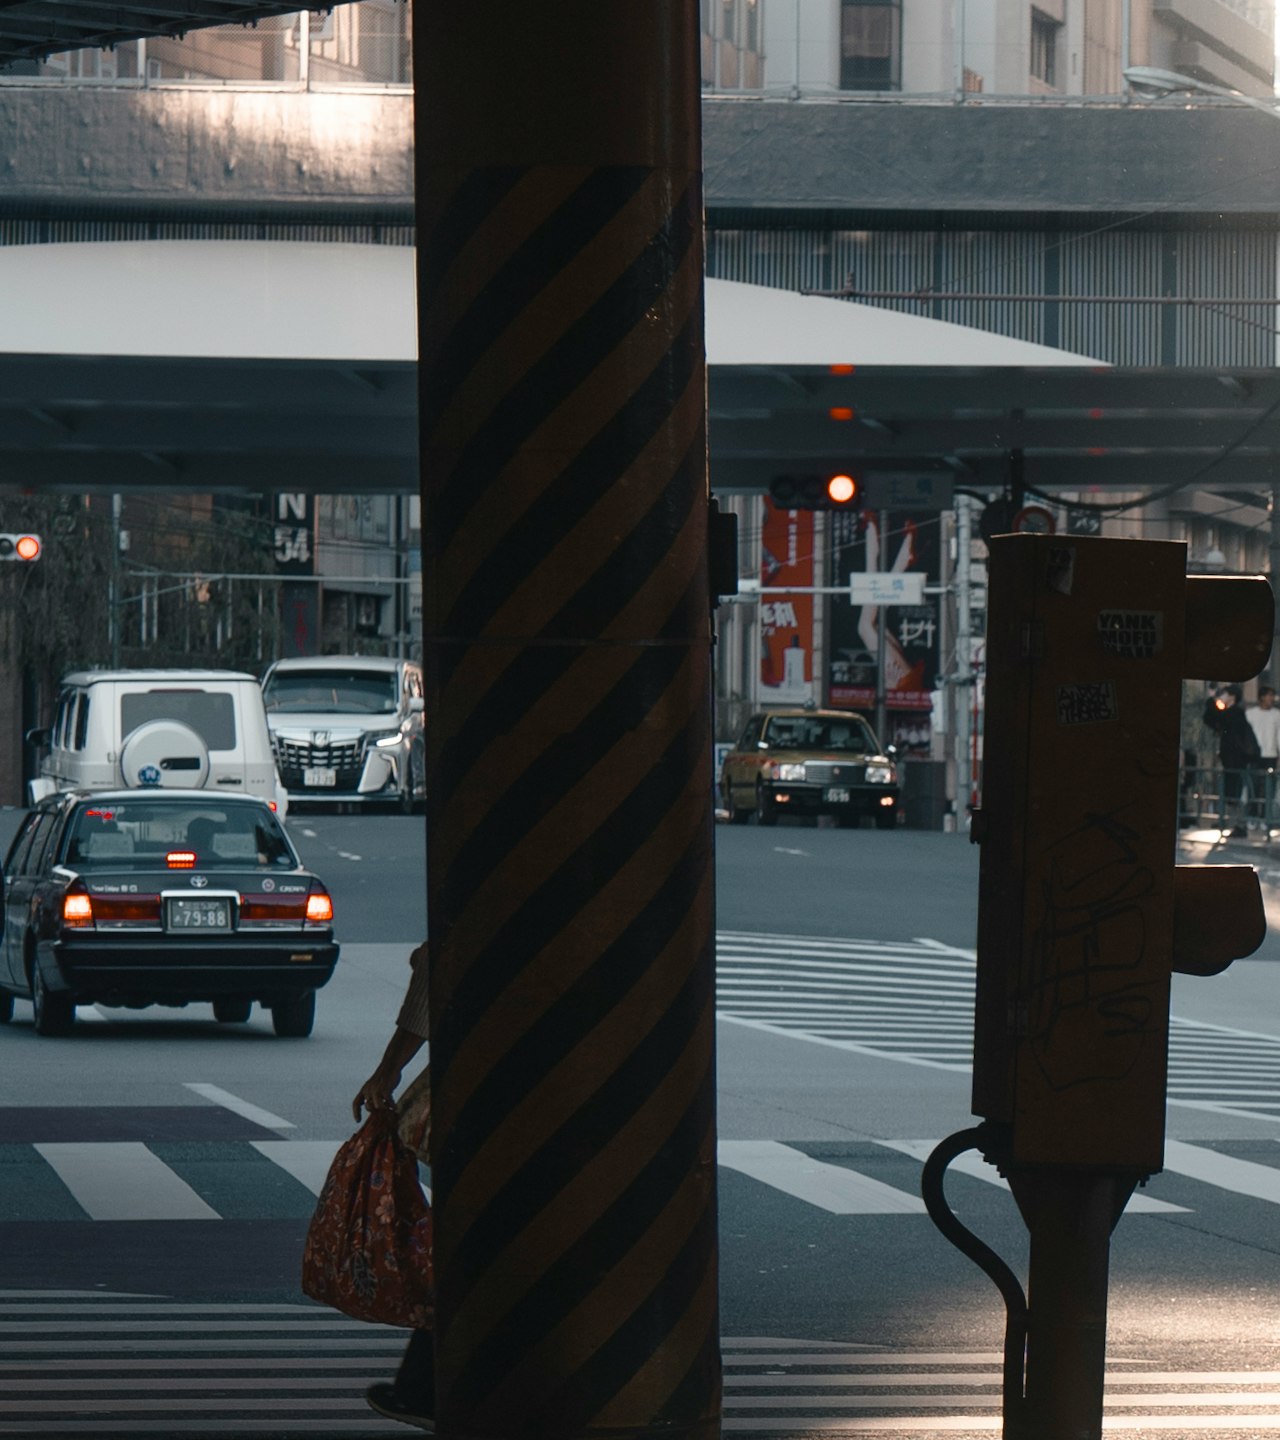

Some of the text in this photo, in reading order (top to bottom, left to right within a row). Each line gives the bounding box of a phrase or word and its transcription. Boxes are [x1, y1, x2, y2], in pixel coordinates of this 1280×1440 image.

[274, 526, 310, 564] 54
[1099, 613, 1156, 630] YANK
[183, 911, 226, 926] 79-88
